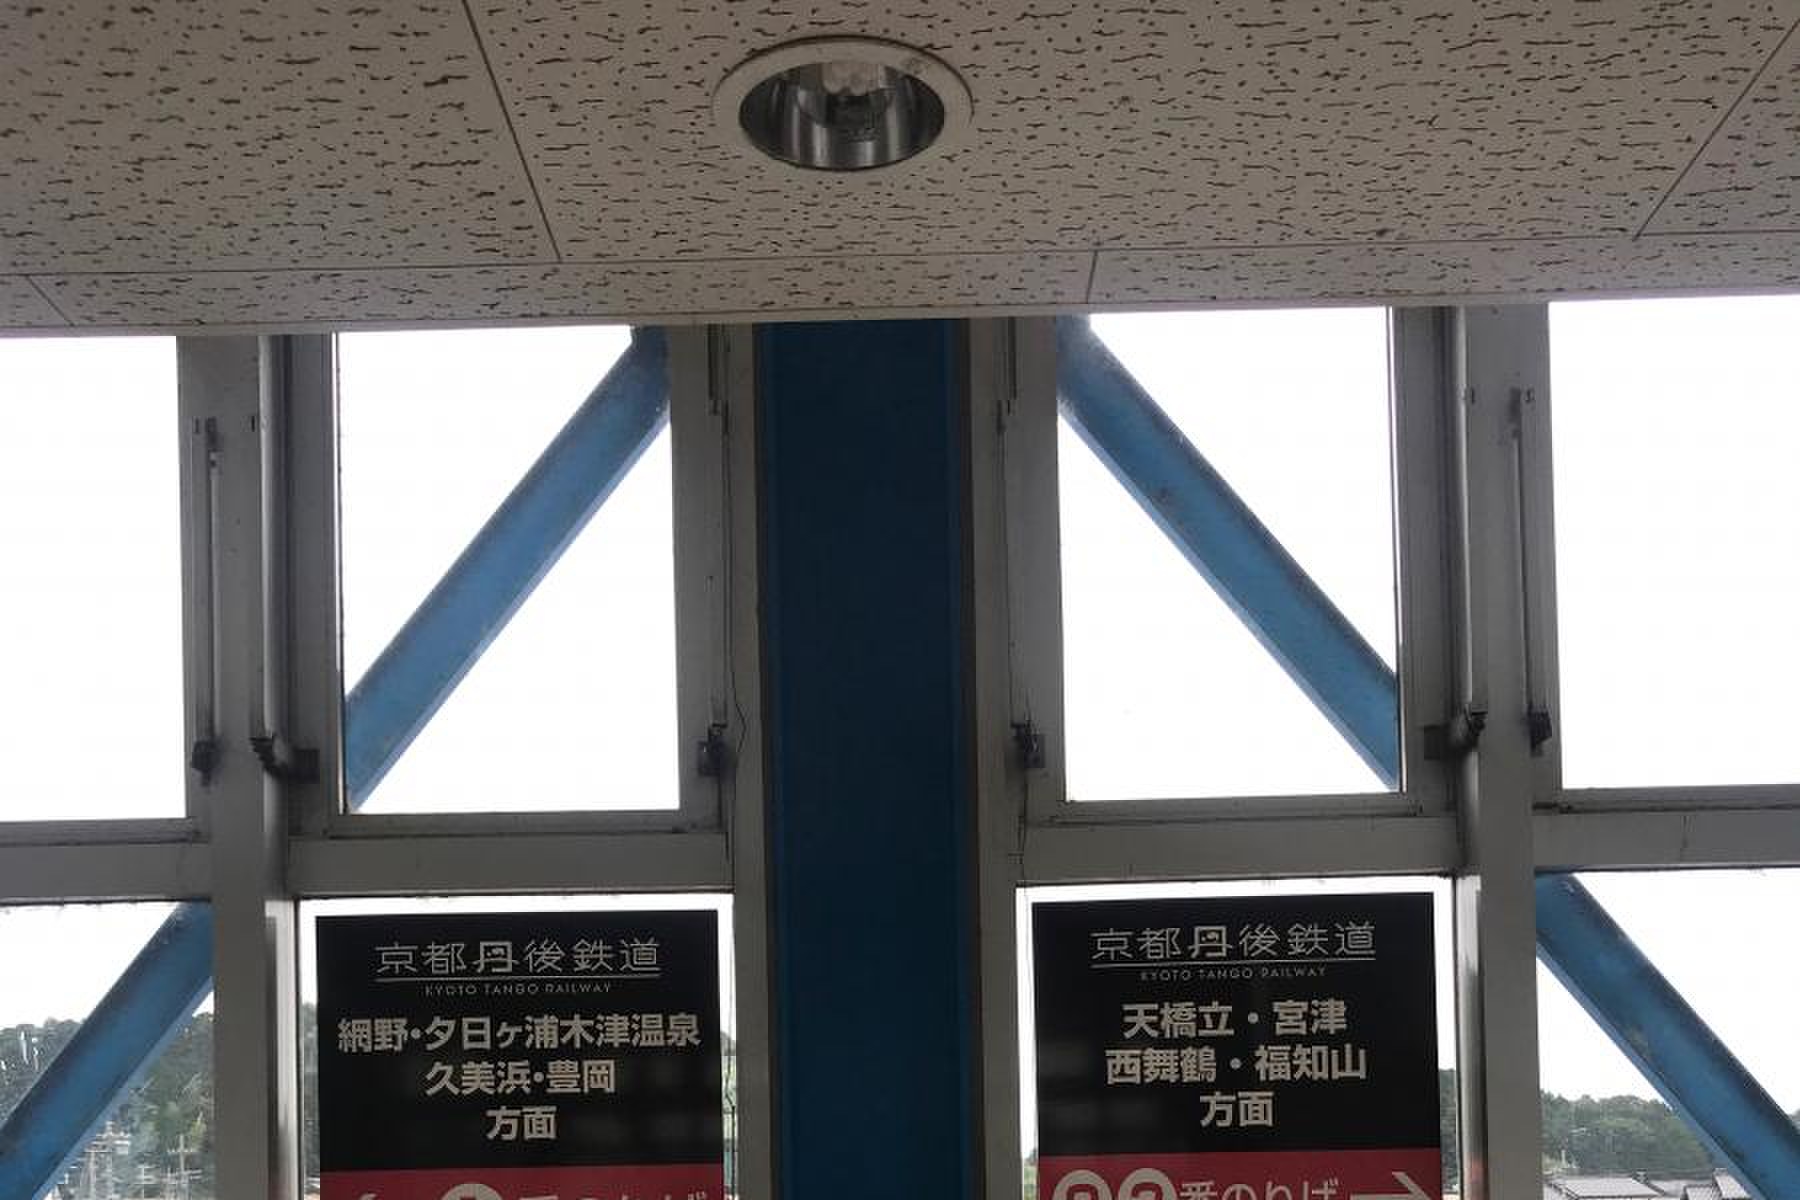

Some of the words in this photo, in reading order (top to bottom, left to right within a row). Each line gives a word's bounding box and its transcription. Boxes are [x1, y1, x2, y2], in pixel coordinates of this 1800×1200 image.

[375, 937, 660, 975] 京都丹後鉄道
[1090, 922, 1377, 960] 京都丹後鉄道
[425, 983, 477, 997] KYOTO
[484, 982, 539, 996] TANGO
[545, 981, 612, 995] RAILWAY
[1140, 968, 1192, 982] KYOTO
[1199, 967, 1254, 980] TANGO
[1261, 966, 1327, 979] RAILWAY
[425, 1059, 616, 1097] 久美浜・豊岡
[485, 1105, 557, 1141] 方面
[1199, 1091, 1275, 1128] 方面
